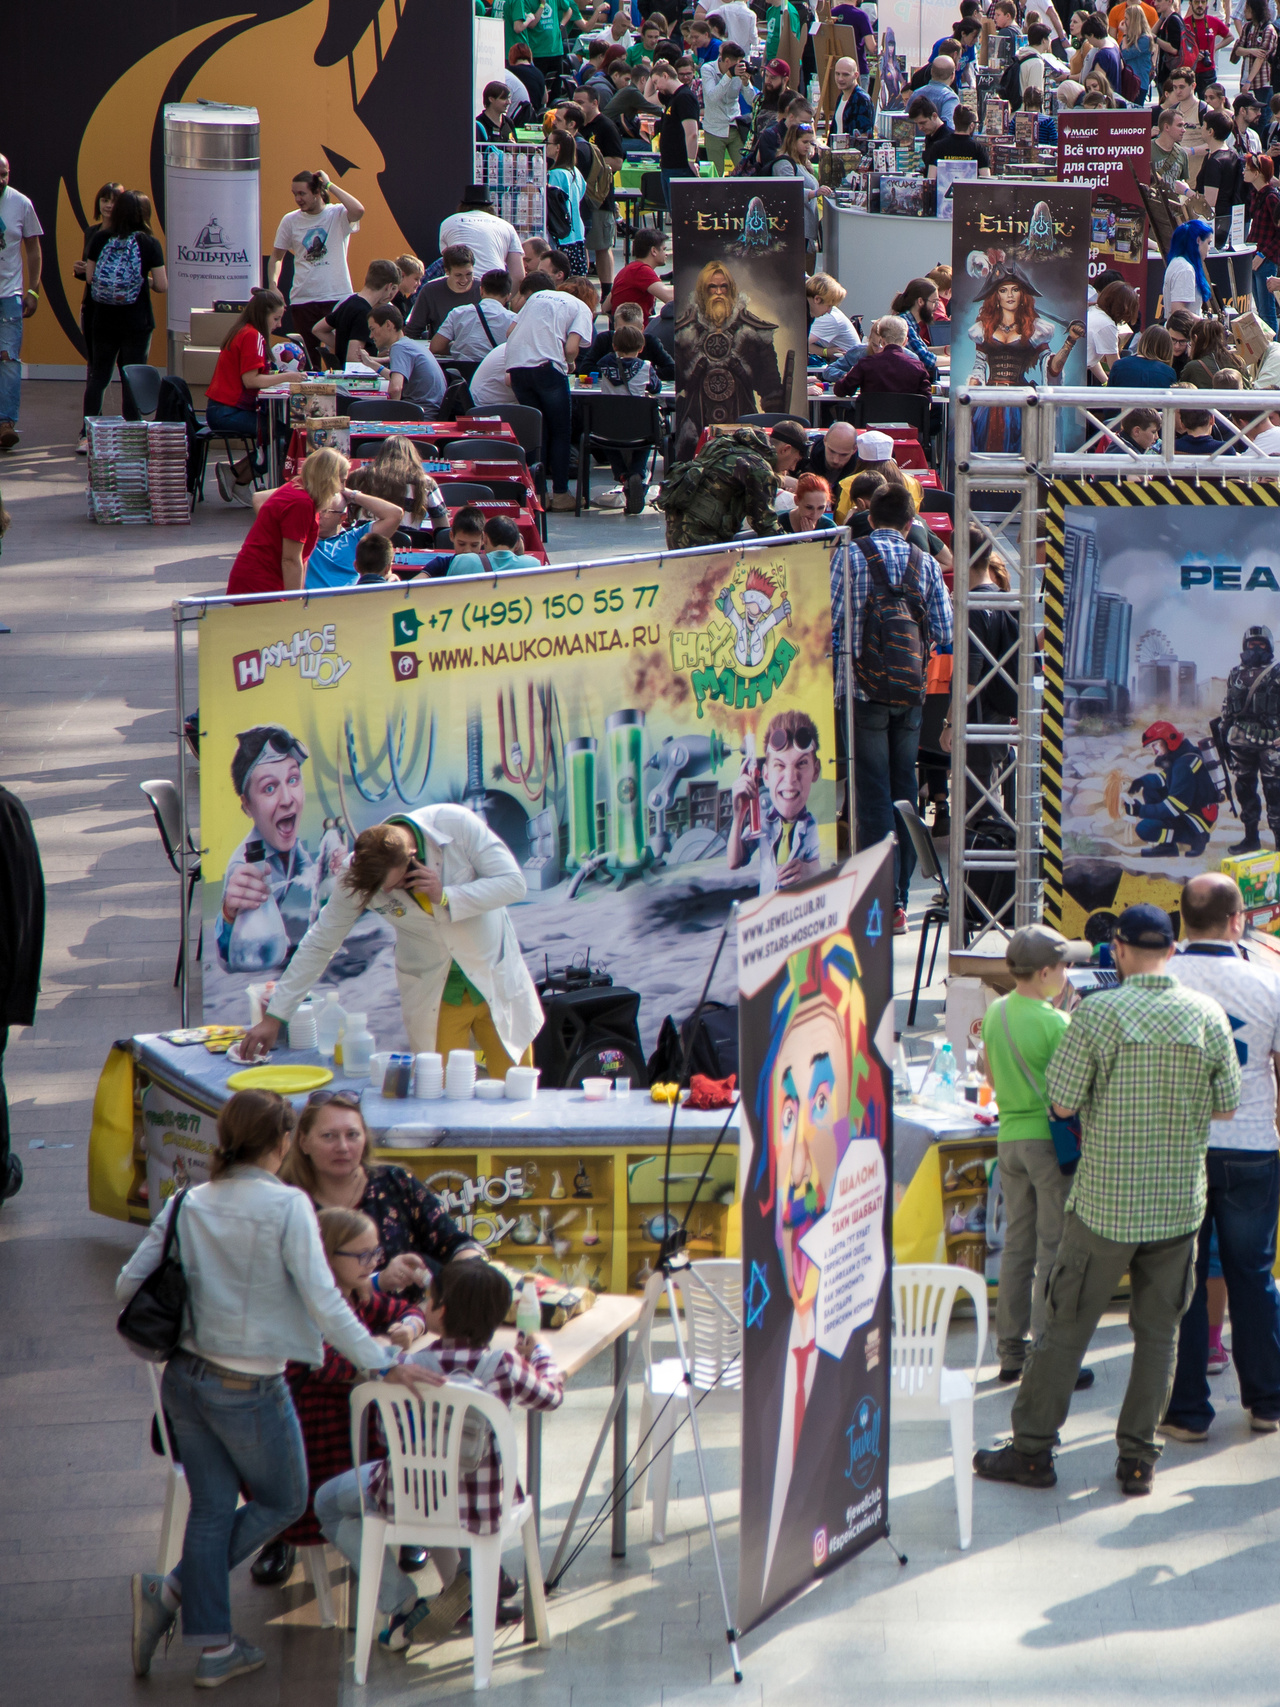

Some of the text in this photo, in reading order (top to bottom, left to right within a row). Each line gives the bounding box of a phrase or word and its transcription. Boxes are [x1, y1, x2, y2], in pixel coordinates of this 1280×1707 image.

[1064, 144, 1144, 158] Всё что нужно
[1071, 128, 1099, 136] MAGIC
[1063, 161, 1123, 174] для старта
[1073, 175, 1109, 189] Magic!
[429, 584, 660, 633] +7 (495) 150 55 77
[236, 624, 337, 688] НАУЧНОЕ
[429, 624, 660, 673] WWW.NAUKOMANIA.RU
[300, 652, 351, 687] ШОУ
[742, 894, 826, 944] WWW.JEWELLCLUB.RU
[742, 911, 838, 968] WWW.STARS-MOSCOW.RU
[839, 1159, 879, 1198] ШАЛОМ!
[831, 1215, 850, 1237] ТАКИ
[845, 1406, 881, 1478] Jewell
